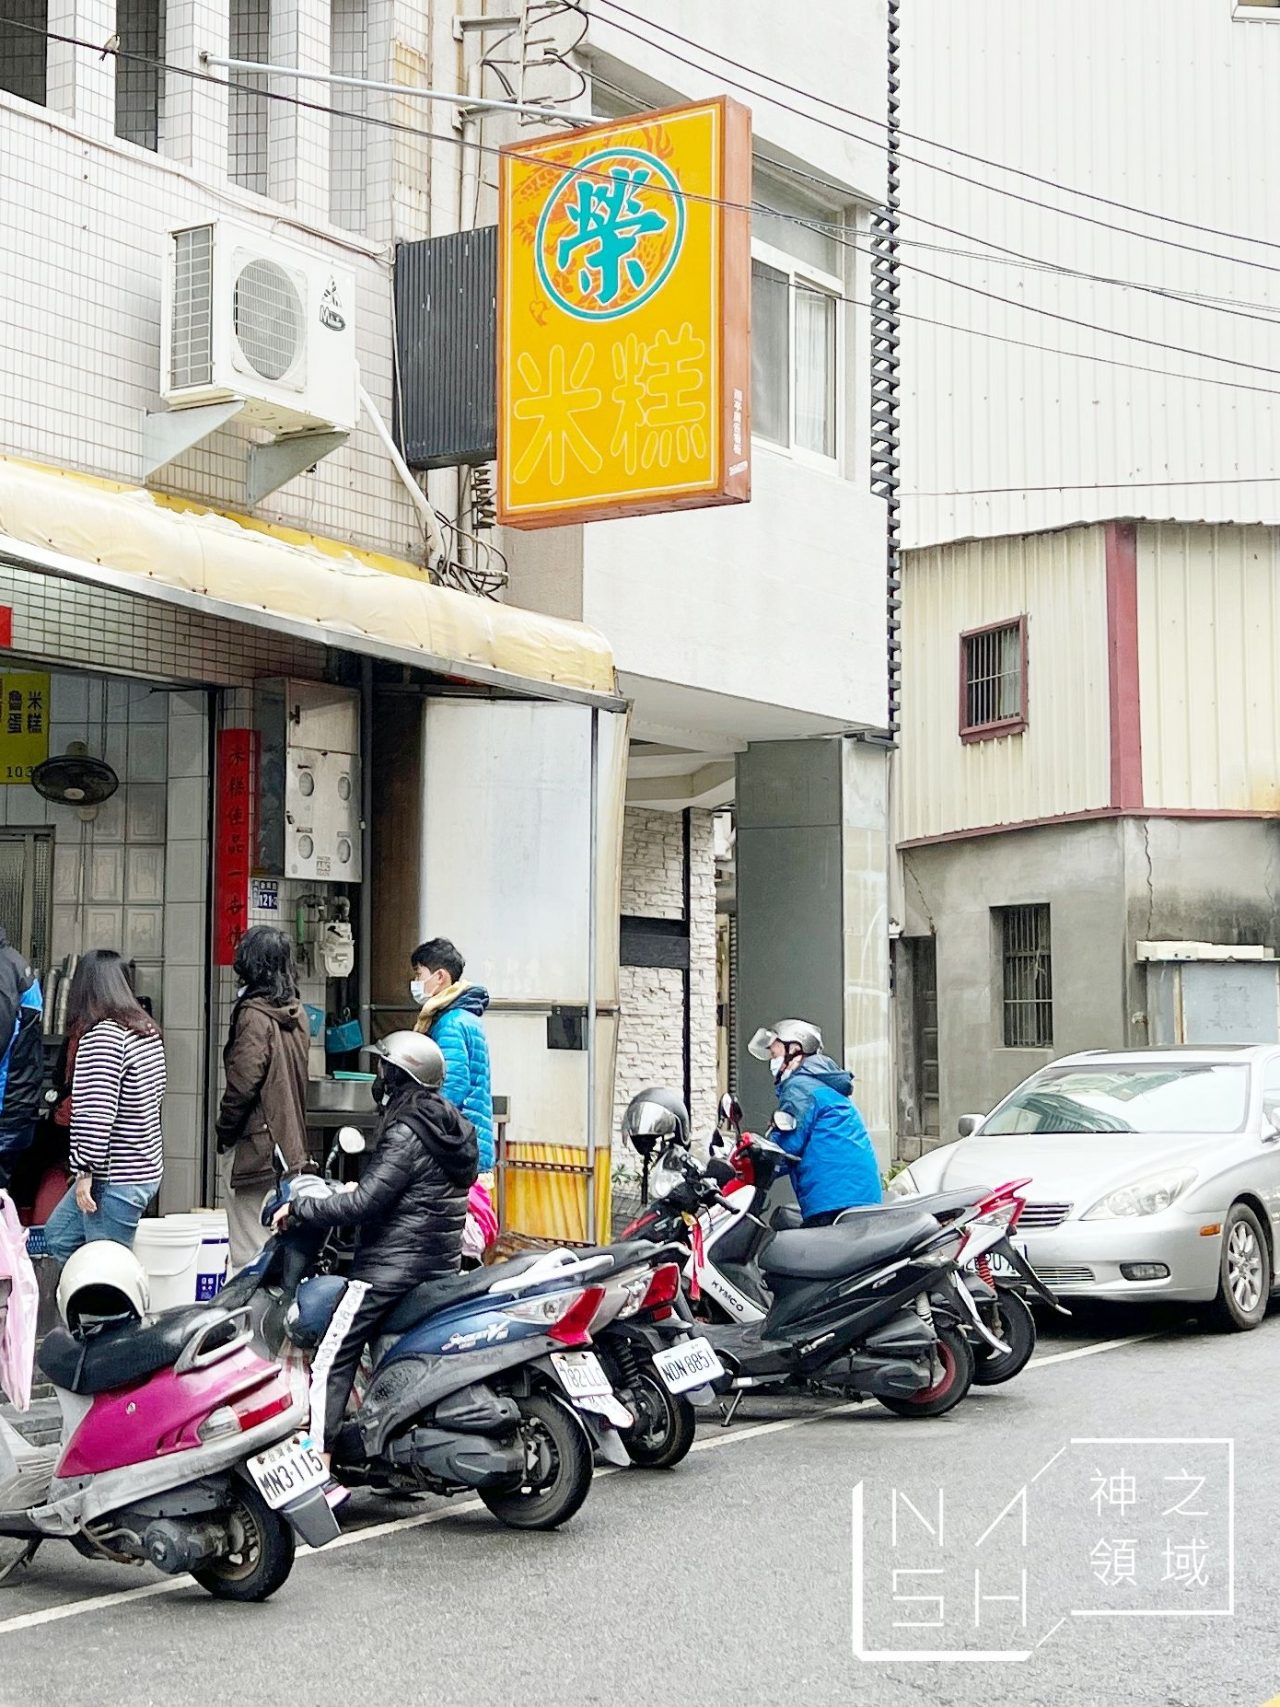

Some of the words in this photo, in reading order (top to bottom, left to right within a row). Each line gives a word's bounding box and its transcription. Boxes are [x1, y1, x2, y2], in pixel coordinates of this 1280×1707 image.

[558, 166, 668, 304] 榮
[513, 321, 708, 486] 米糕
[27, 690, 42, 733] 米糕
[7, 766, 22, 778] 10
[711, 1280, 744, 1312] KYMCO
